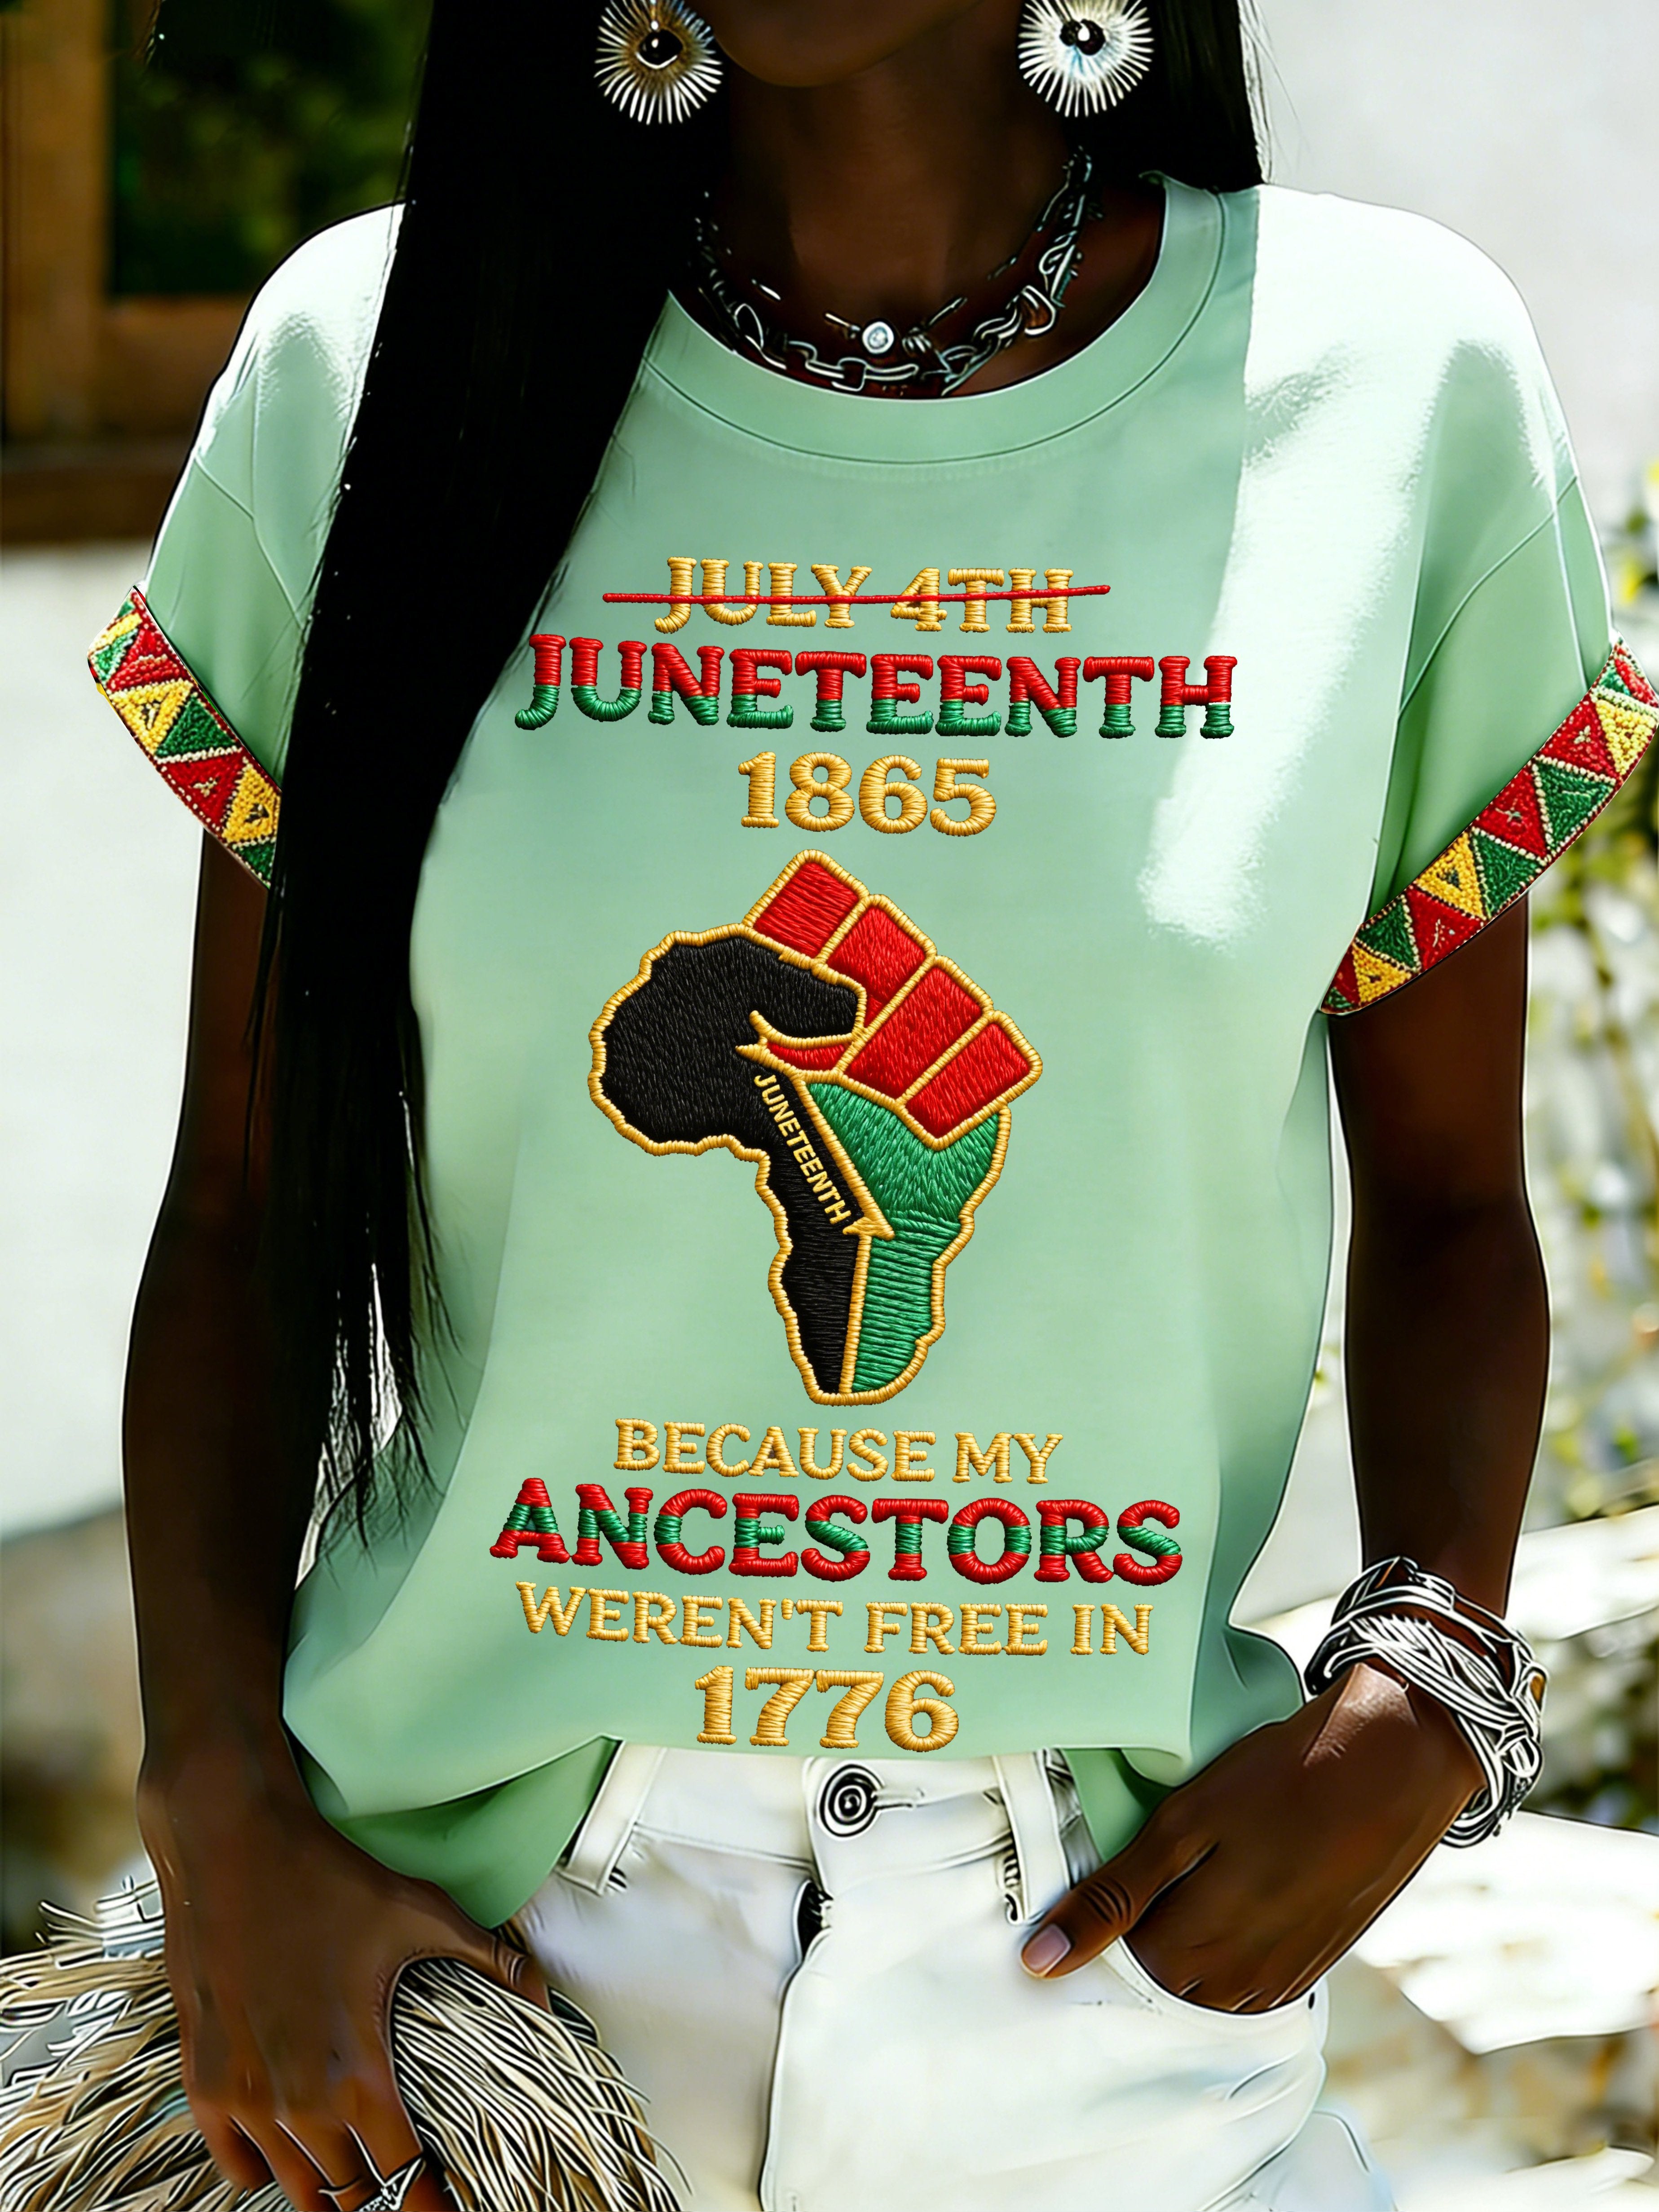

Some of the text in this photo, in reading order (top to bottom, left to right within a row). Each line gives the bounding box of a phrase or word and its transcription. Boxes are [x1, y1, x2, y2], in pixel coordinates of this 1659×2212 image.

[654, 556, 1074, 634] JULY 4TH
[515, 633, 1237, 739] JUNETEENTH
[738, 751, 997, 837] 1865
[754, 1074, 852, 1224] JUNETEENTH
[614, 1417, 1064, 1484] BECAUSE MY
[490, 1477, 1182, 1586] ANCESTORS
[516, 1581, 1155, 1656] WEREN'T FREE IN
[695, 1665, 959, 1753] 1776
